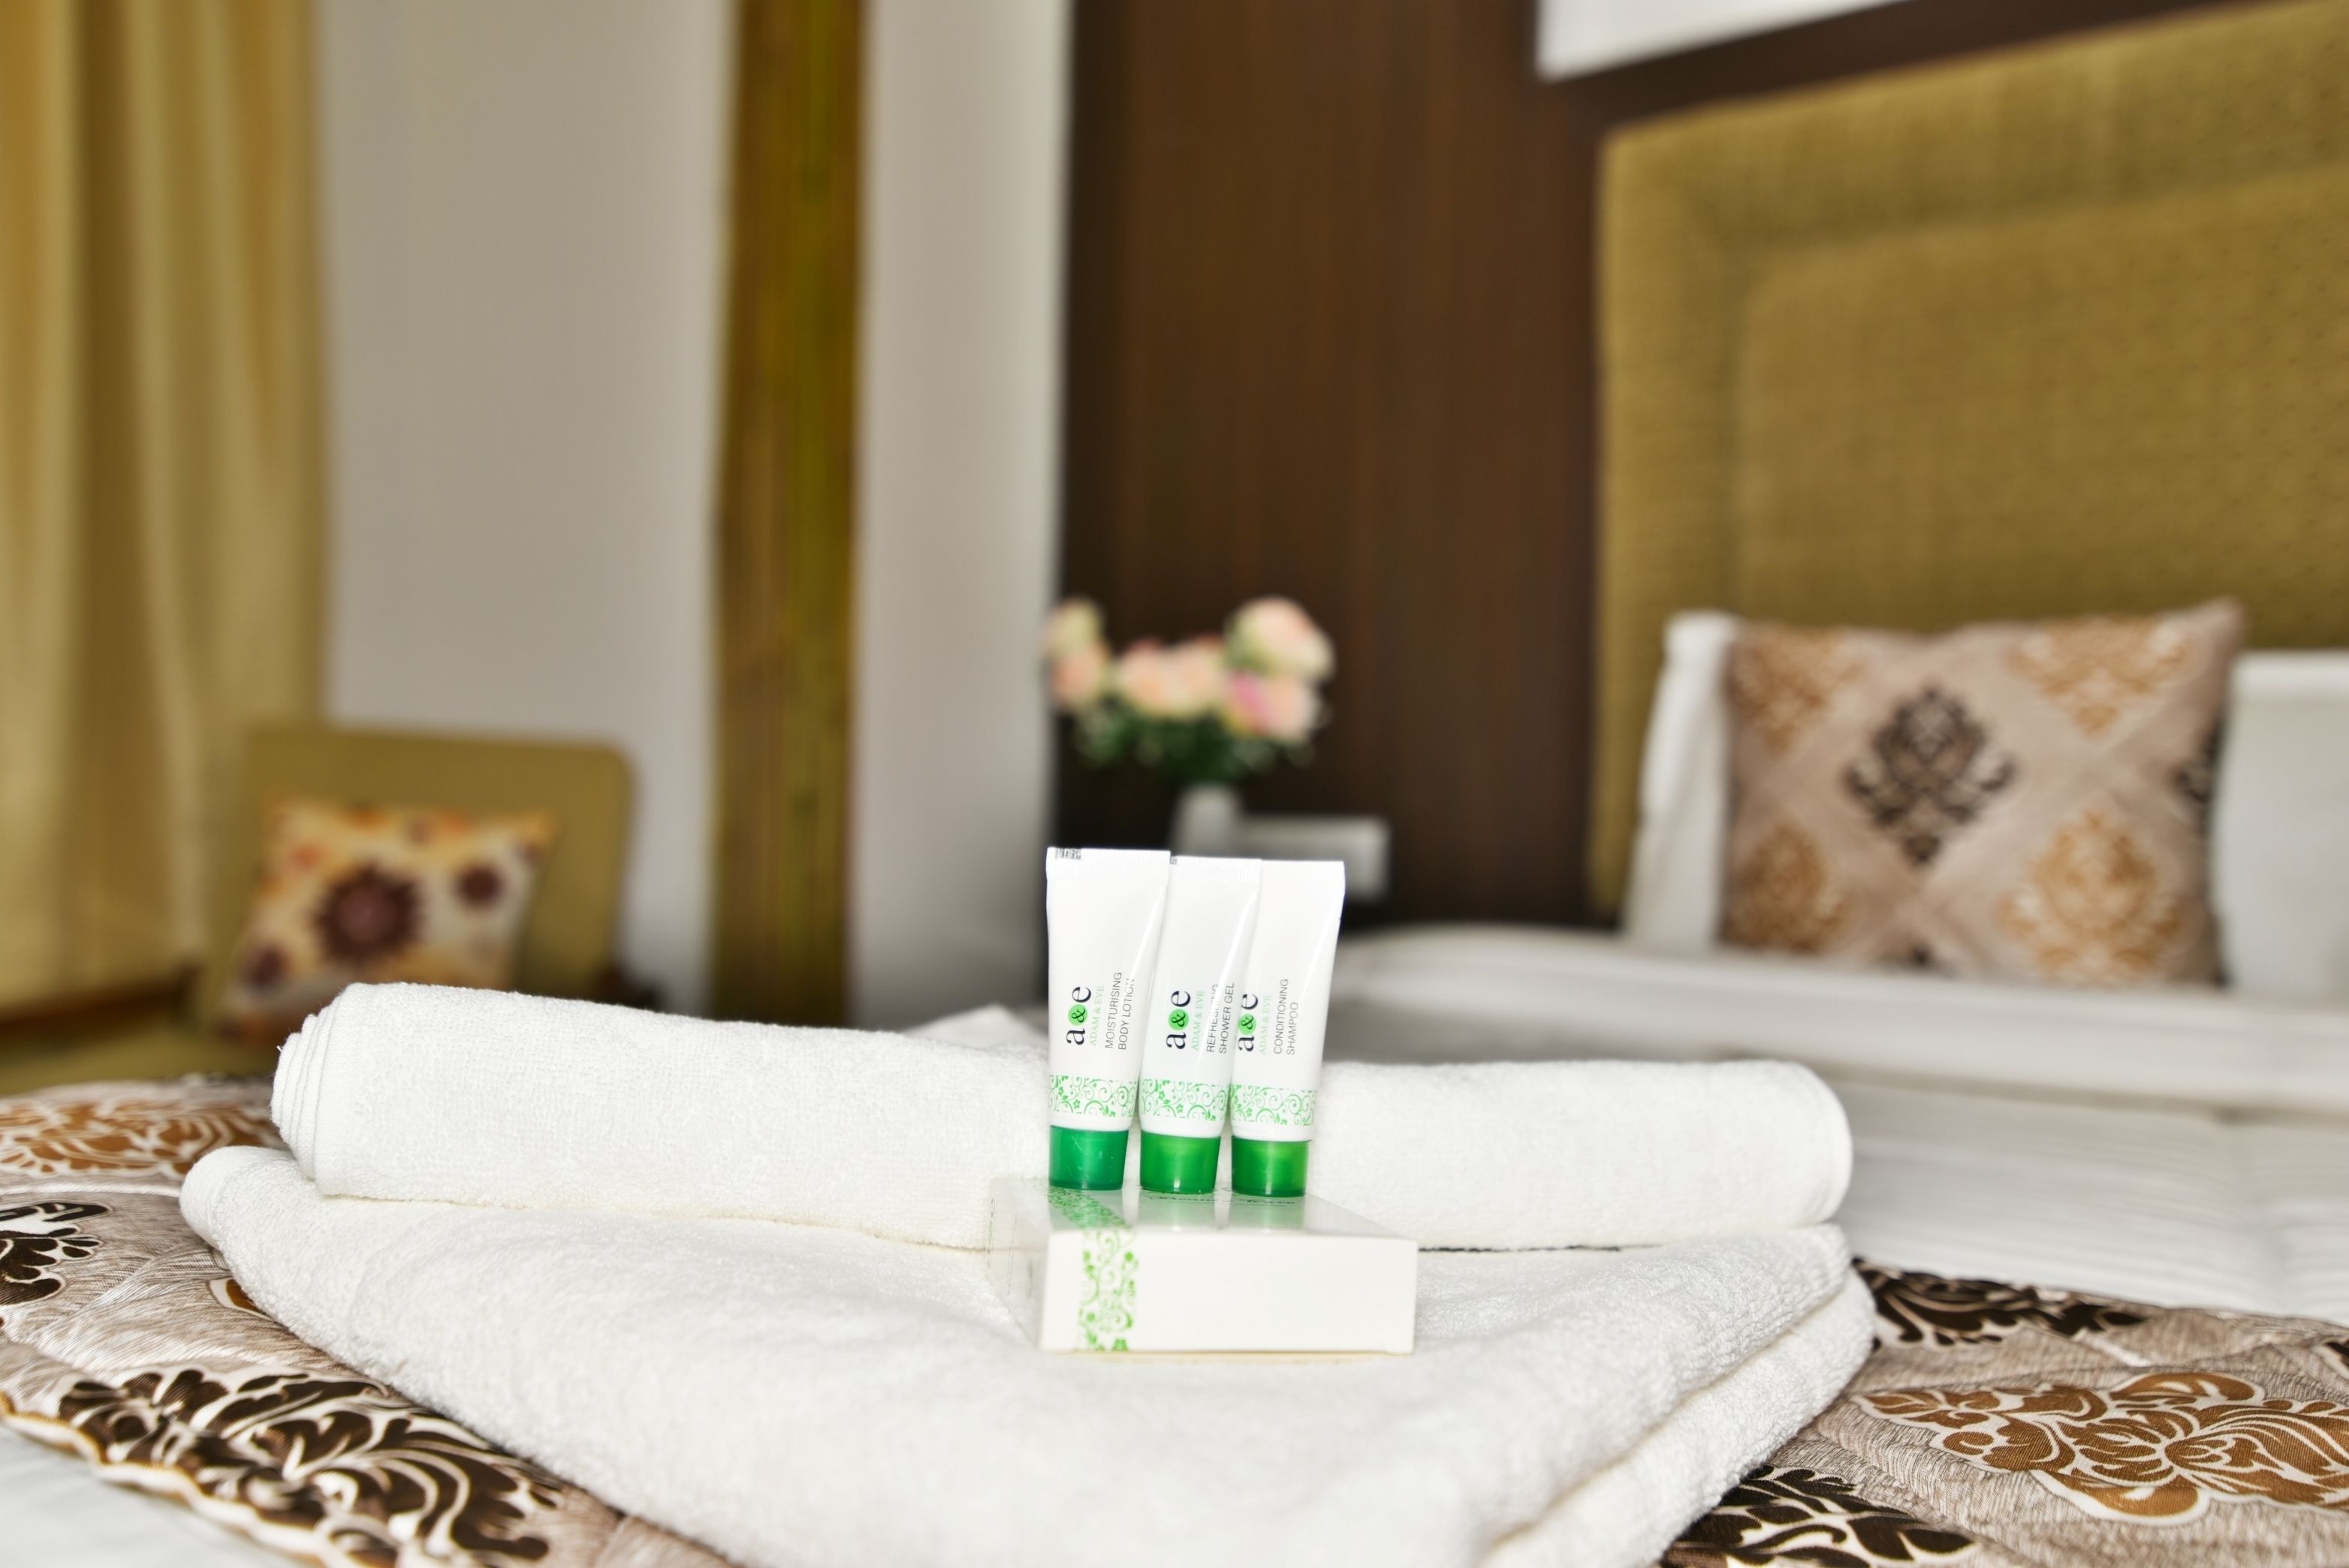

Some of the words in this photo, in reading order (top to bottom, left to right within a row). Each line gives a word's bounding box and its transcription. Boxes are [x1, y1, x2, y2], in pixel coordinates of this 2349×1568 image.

[1066, 986, 1092, 1045] a&e
[1090, 1017, 1099, 1046] ADAM
[1095, 985, 1105, 1005] EVE
[1105, 972, 1123, 1049] MOISTURISING
[1196, 991, 1205, 1009] EVE
[1224, 982, 1235, 1003] GEL
[1262, 995, 1271, 1014] EVE
[1274, 978, 1289, 1054] CONDITIONING
[1117, 1020, 1129, 1050] BODY
[1165, 991, 1191, 1050] a&e
[1191, 1022, 1202, 1051] ADAM
[1219, 1006, 1232, 1054] SHOWER
[1259, 1025, 1268, 1055] ADAM
[1286, 1003, 1298, 1055] SHAMPOO
